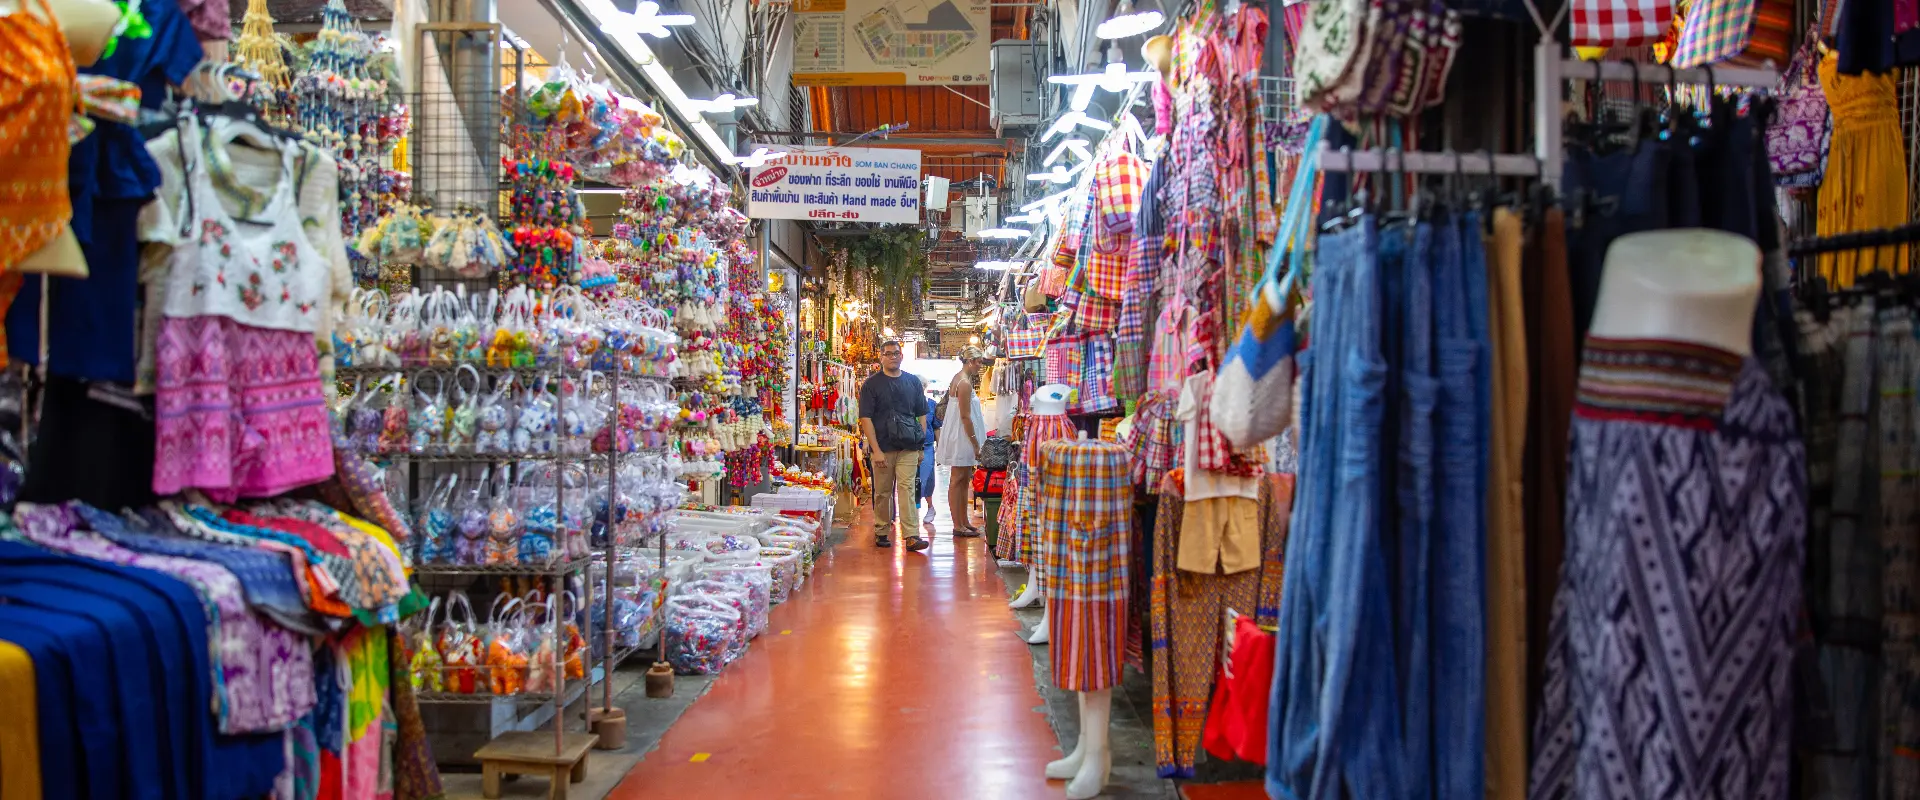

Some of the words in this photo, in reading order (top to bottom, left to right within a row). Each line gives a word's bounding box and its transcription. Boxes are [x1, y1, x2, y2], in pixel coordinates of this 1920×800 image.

[855, 160, 872, 168] SOM
[890, 162, 917, 170] CHANG
[754, 168, 786, 187] จำหน่าย
[788, 173, 822, 186] ของฝาก
[825, 170, 851, 187] ที่ระลึก
[855, 173, 881, 188] ของใช้
[884, 175, 917, 189] งานฝีมือ
[751, 186, 800, 203] สินค้าพื้นบ้าน
[804, 191, 839, 205] และสินค้า
[842, 194, 866, 206] Hand
[870, 195, 896, 207] made
[900, 191, 917, 210] อื่นๆ
